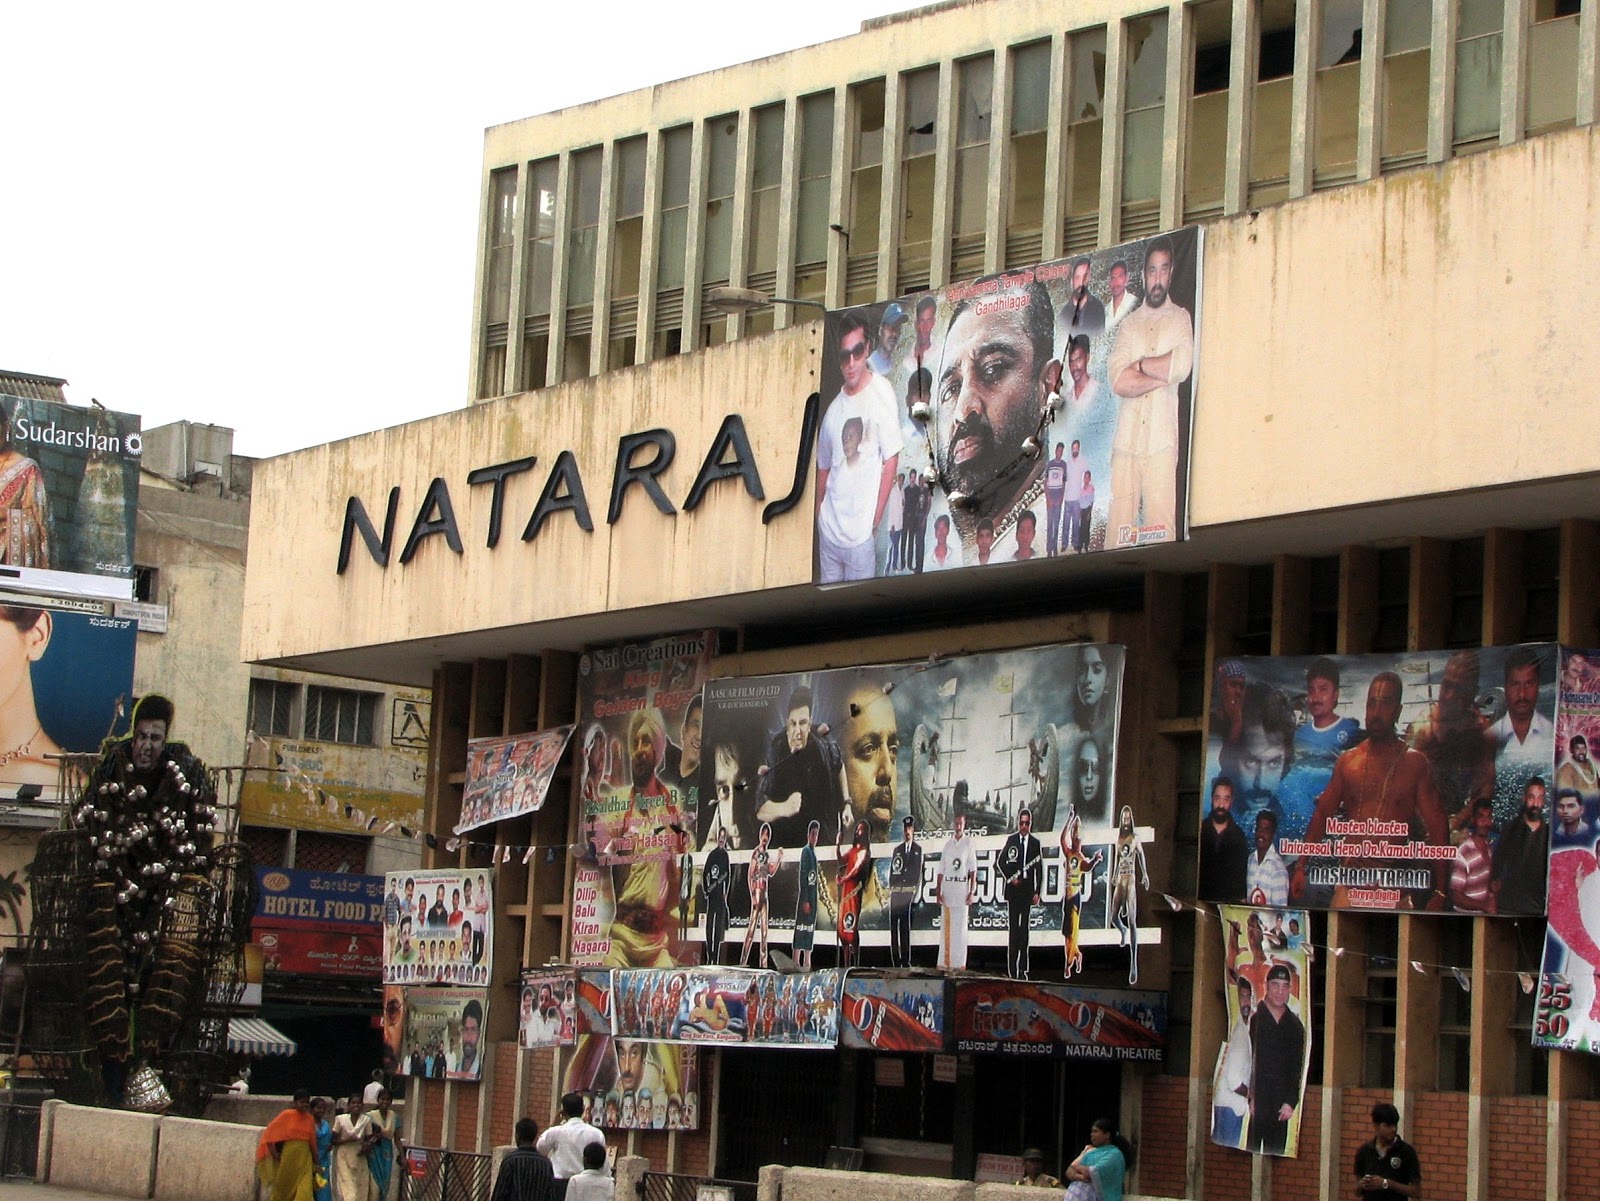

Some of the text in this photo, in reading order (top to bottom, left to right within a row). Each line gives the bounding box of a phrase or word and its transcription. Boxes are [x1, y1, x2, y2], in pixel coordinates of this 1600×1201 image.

[16, 418, 120, 453] Sudarshan
[337, 391, 819, 576] NATARAJ
[89, 617, 131, 630] ಸುದರ್ಶನ್
[623, 638, 705, 666] Creations
[709, 688, 736, 699] AASCAR
[738, 687, 755, 697] FILM
[766, 685, 780, 696] LTD
[593, 696, 647, 718] Golden
[1326, 817, 1408, 836] Master blaster
[1334, 840, 1361, 857] Hero
[1415, 841, 1457, 860] Hassan
[577, 870, 600, 883] Arun
[576, 887, 597, 903] Dilip
[1348, 887, 1401, 903] shreya digital
[264, 895, 320, 918] HOTEL
[323, 900, 367, 921] FOOD
[575, 905, 596, 918] Balu
[574, 922, 599, 935] Kiran
[574, 939, 611, 955] Nagaraj
[1540, 981, 1572, 1011] 25
[1536, 1009, 1570, 1039] 50
[958, 1038, 1053, 1055] ನಟರಾಜ್ ಚಿತ್ರಮಂದಿರ
[1066, 1044, 1162, 1061] NATARAJ THEATRE
